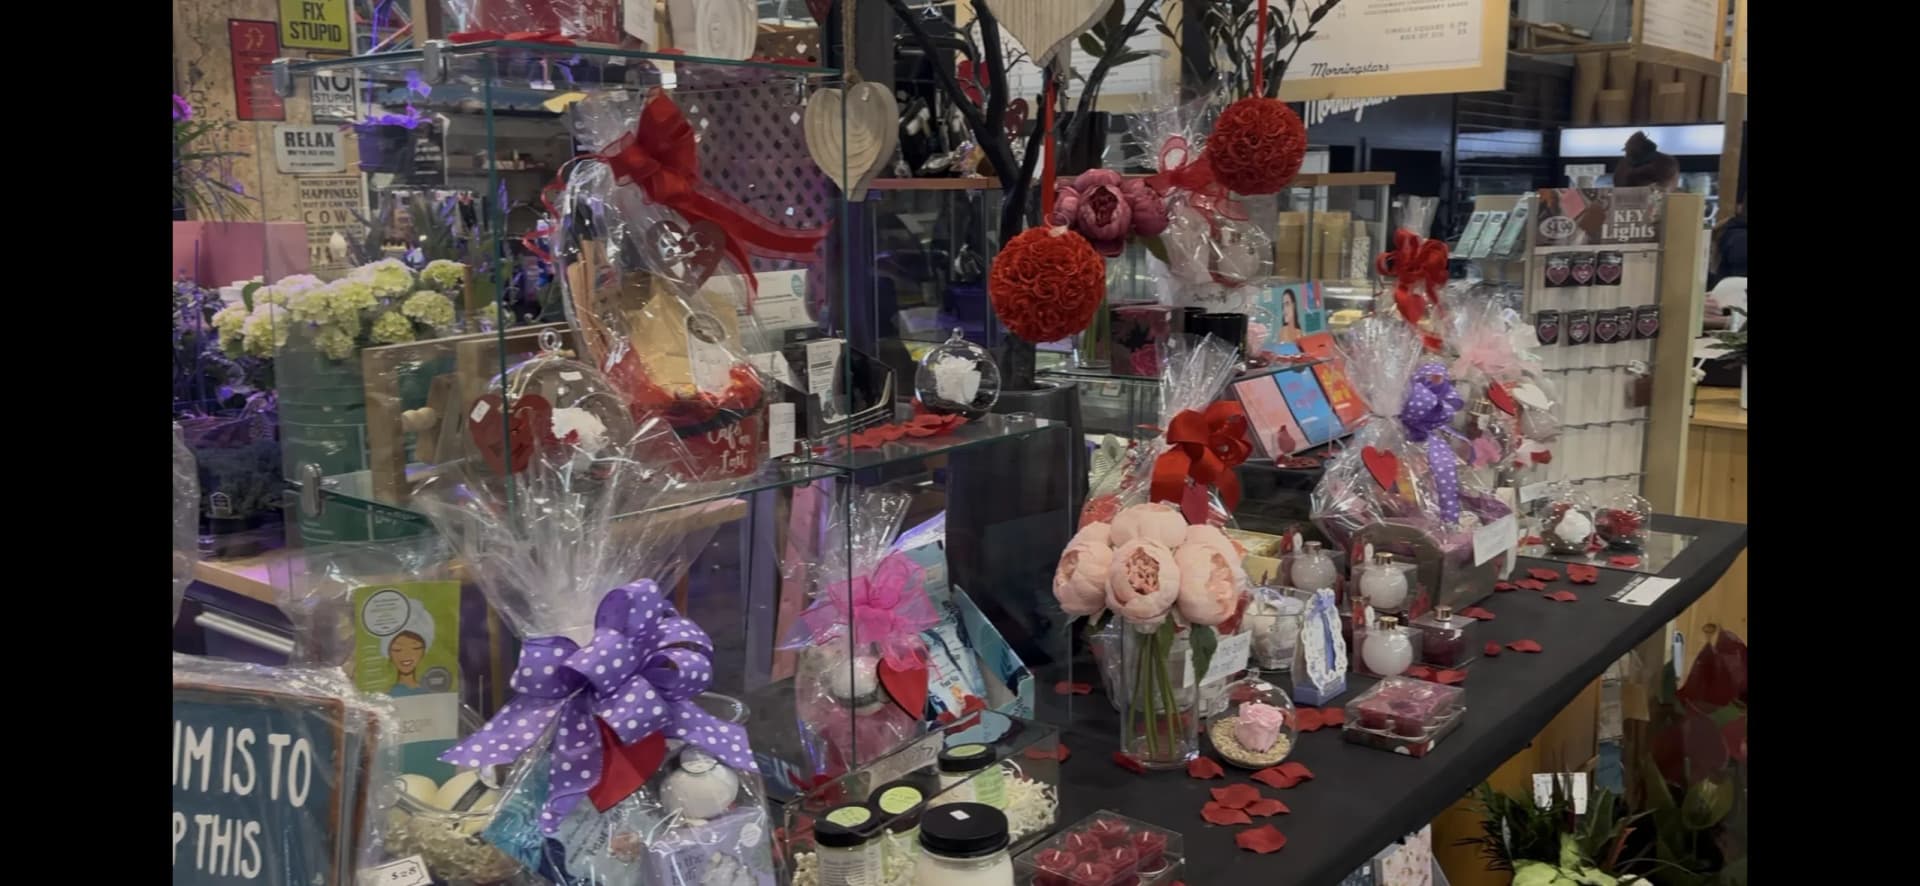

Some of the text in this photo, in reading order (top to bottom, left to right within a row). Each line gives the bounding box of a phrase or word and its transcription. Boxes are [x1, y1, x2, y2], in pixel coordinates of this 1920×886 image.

[303, 2, 325, 21] FIX
[289, 21, 342, 42] STUPID
[1309, 62, 1390, 78] Morningstars
[313, 76, 350, 92] NO
[315, 93, 352, 104] STUPID
[284, 131, 335, 148] RELAX
[301, 189, 359, 200] HAPPINESS
[1614, 209, 1647, 223] KEY
[1601, 224, 1655, 242] Lights
[223, 726, 256, 796] IS
[267, 732, 311, 808] TO
[194, 814, 262, 879] THIS
